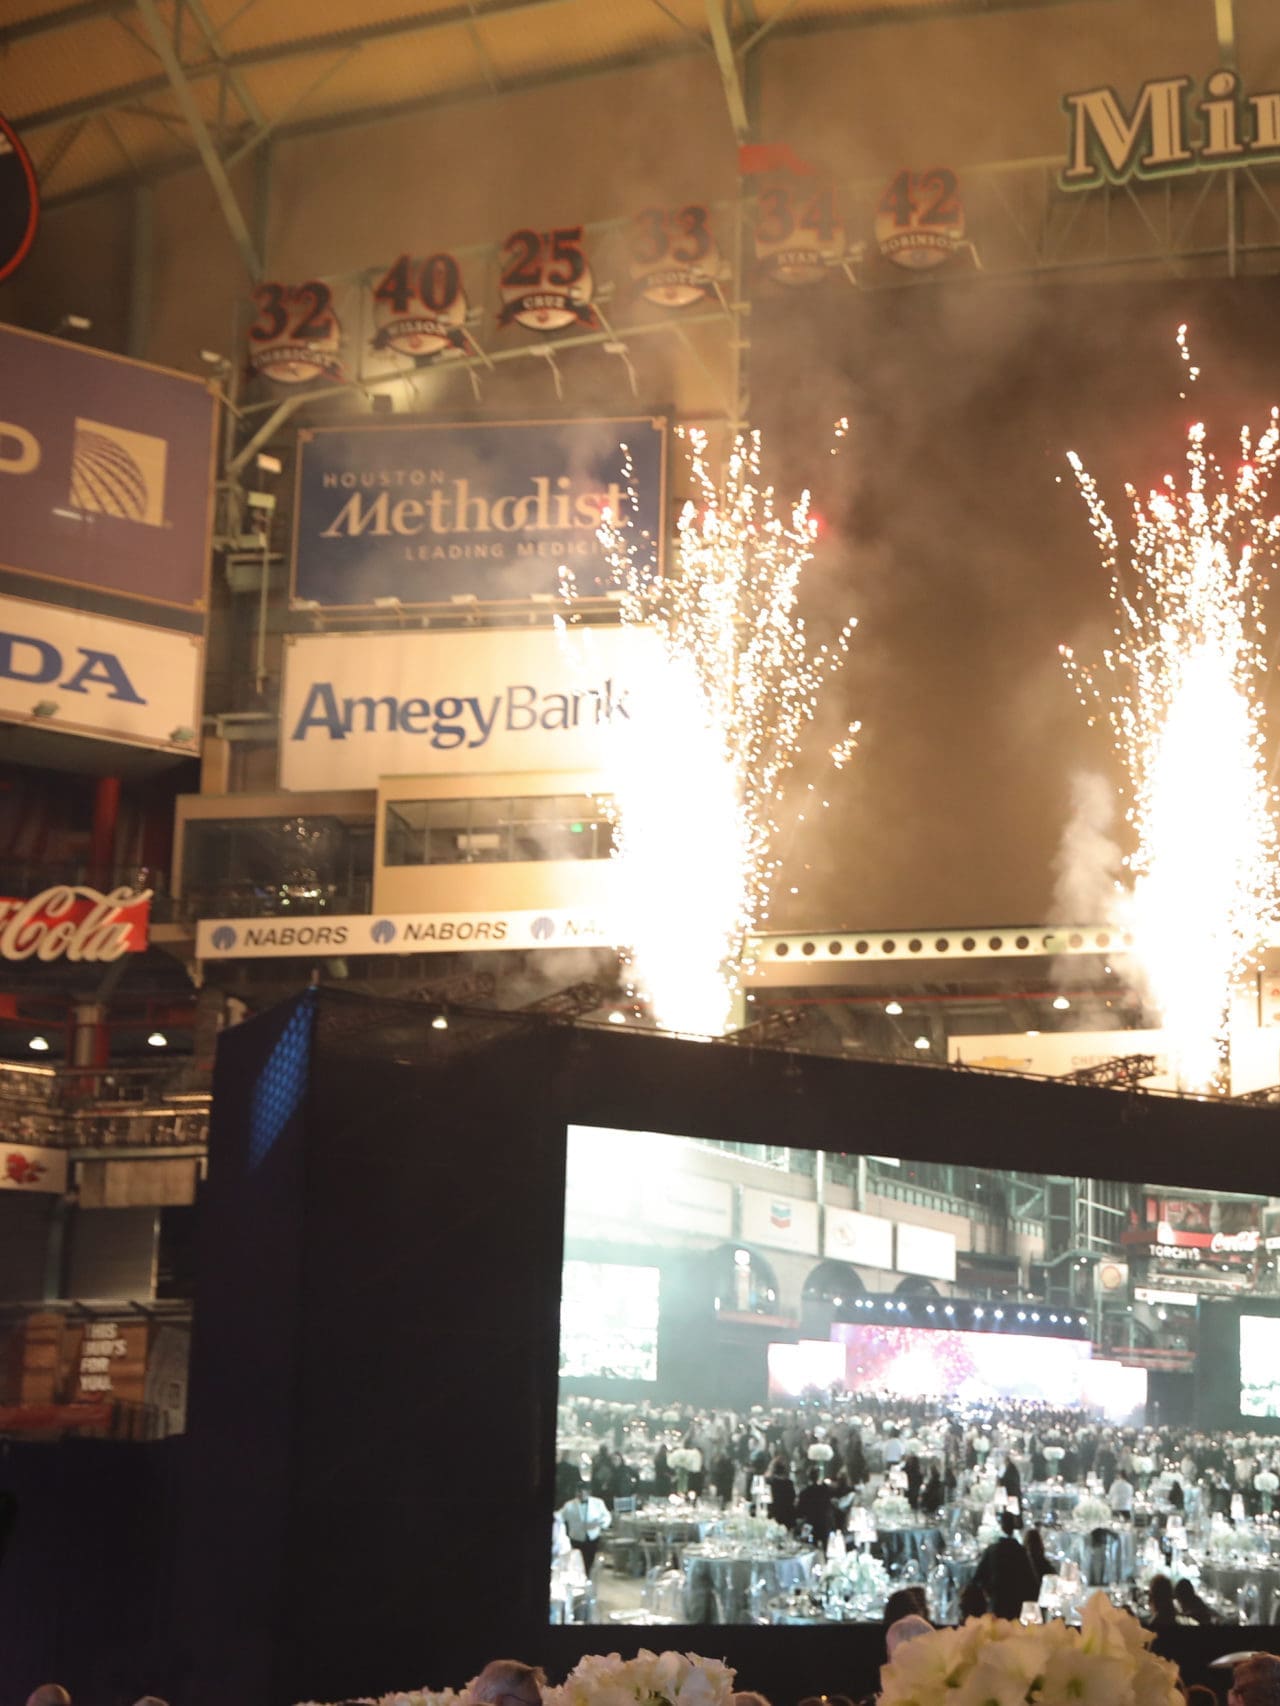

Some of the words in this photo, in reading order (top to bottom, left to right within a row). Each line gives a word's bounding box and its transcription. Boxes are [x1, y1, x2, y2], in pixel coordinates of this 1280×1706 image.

[757, 183, 843, 244] 34
[877, 166, 961, 227] 42
[501, 226, 583, 287] 25
[631, 204, 711, 264] 33
[250, 280, 333, 342] 32
[375, 253, 461, 315] 40
[318, 475, 629, 538] Methodist
[322, 469, 446, 489] HOUSTON
[405, 543, 505, 561] LEADING
[0, 631, 148, 705] DA
[244, 926, 349, 947] NABORS
[403, 921, 508, 941] NABORS
